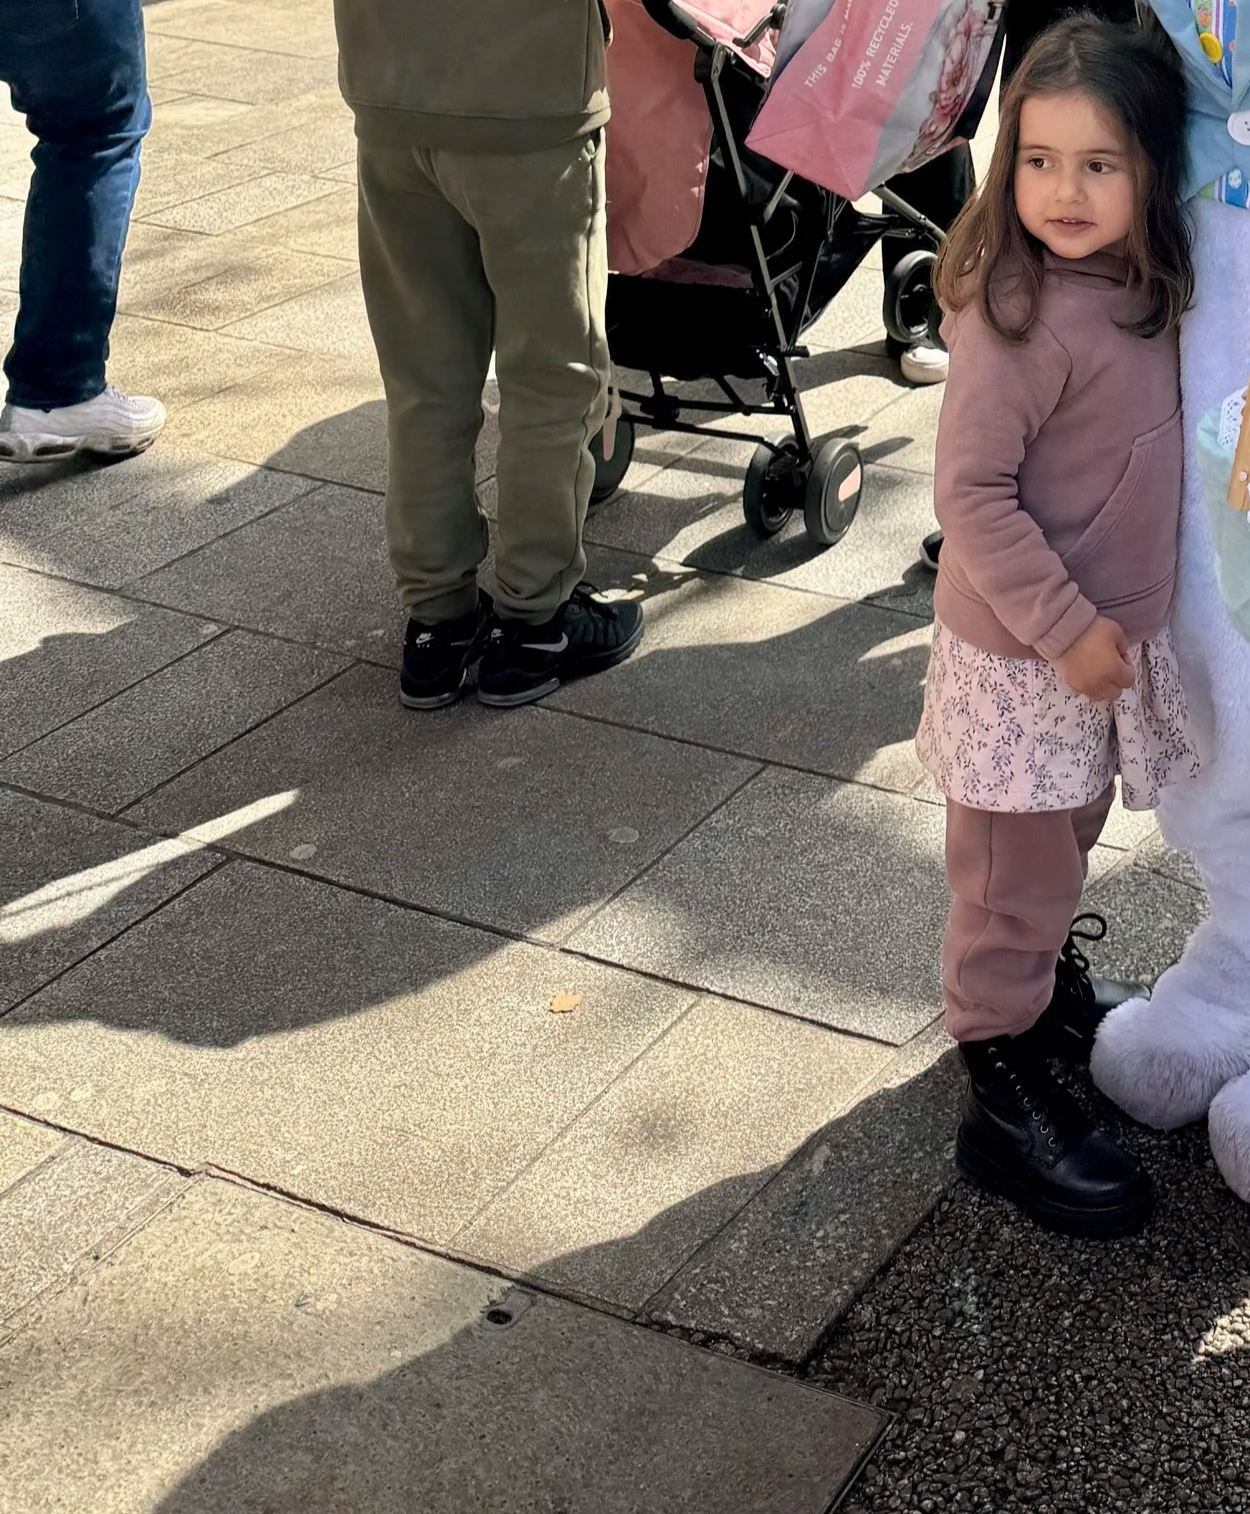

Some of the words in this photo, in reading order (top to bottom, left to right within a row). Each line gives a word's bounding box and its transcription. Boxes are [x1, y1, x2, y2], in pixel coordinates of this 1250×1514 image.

[804, 63, 828, 88] THIS
[826, 38, 842, 62] BAG
[850, 59, 872, 90] 100%
[875, 21, 914, 87] MATERIALS.
